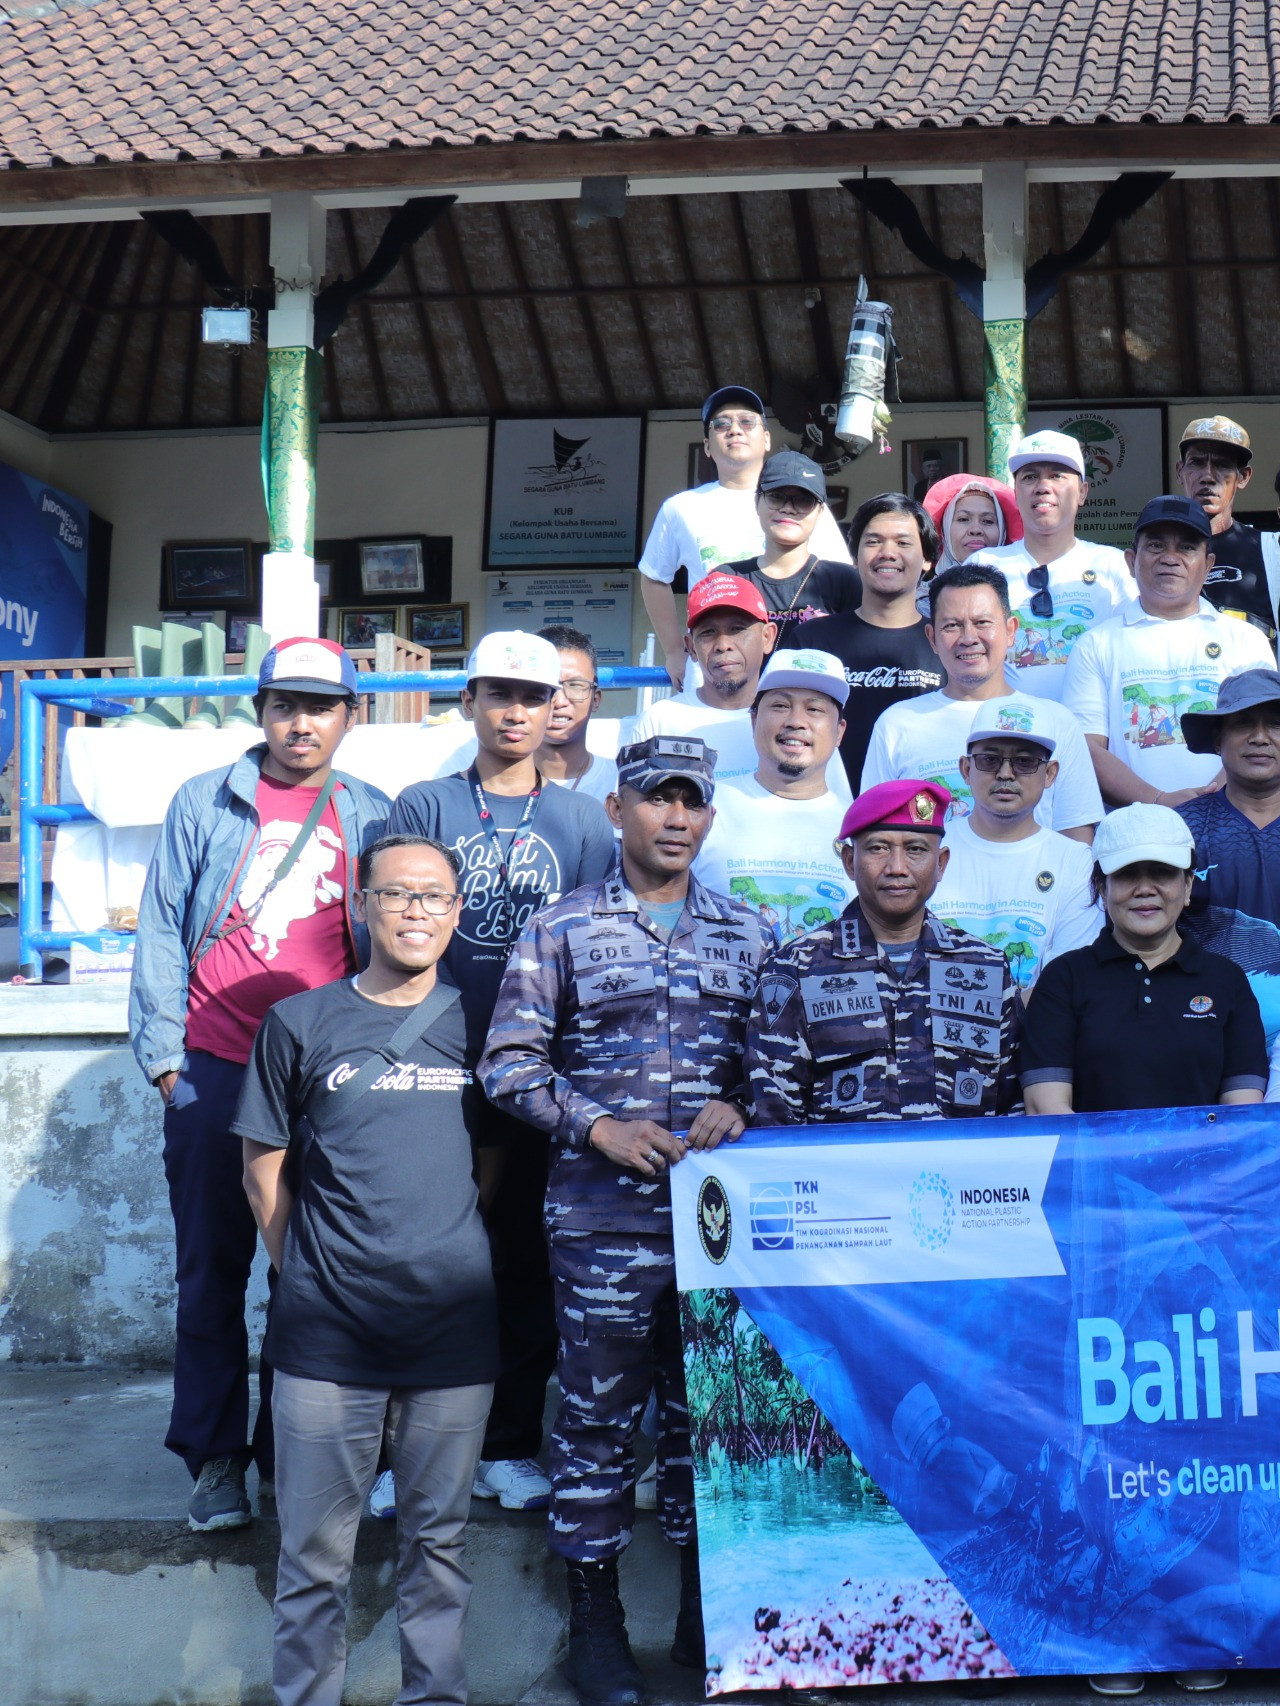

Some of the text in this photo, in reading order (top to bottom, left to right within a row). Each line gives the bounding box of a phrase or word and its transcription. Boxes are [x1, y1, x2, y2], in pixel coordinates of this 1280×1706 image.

[1058, 413, 1126, 468] MINA LESTARI BATU LUMBANG
[563, 482, 577, 490] BATU
[578, 479, 605, 488] LUMBANG
[1084, 498, 1116, 507] AHSAR
[554, 507, 574, 516] KUB
[1076, 511, 1101, 519] golah
[509, 518, 617, 529] (Kelompok Usaha Bersama)
[1083, 523, 1106, 531] BATU
[1108, 522, 1136, 530] LUMBA
[499, 530, 627, 541] SEGARA GUNA BATU LUMBANG
[844, 667, 900, 688] oca-Cola
[898, 669, 941, 680] EUROPACIFIC
[1120, 669, 1136, 680] Bali
[1137, 667, 1178, 678] Harmony
[1189, 664, 1219, 673] Action
[898, 676, 940, 686] PARTNERS
[919, 760, 936, 773] Bali
[727, 858, 746, 869] Bali
[748, 858, 796, 870] Harmony
[798, 859, 808, 869] in
[810, 860, 844, 875] Action
[930, 898, 1044, 912] Bali Harmony in Action
[589, 945, 633, 962] GDE
[702, 946, 755, 967] TNI AL
[811, 996, 876, 1018] DEWA RAKE
[936, 993, 995, 1016] TNI AL
[417, 1067, 473, 1077] EUROPACIFIC
[417, 1076, 473, 1085] PARTNERS
[794, 1180, 819, 1195] TKN
[960, 1187, 1031, 1205] INDONESIA
[795, 1200, 818, 1214] PSL
[961, 1206, 1022, 1217] NATIONAL PLASTIC
[962, 1217, 1031, 1229] ACTION PARTNERSHIP
[796, 1225, 889, 1237] TIM KOORDINASI NASIONAL
[796, 1238, 893, 1250] PENANGANAN SAMPAH LAUT
[1077, 1307, 1222, 1426] Bali
[1106, 1460, 1171, 1499] Let's
[1177, 1457, 1254, 1496] clean
